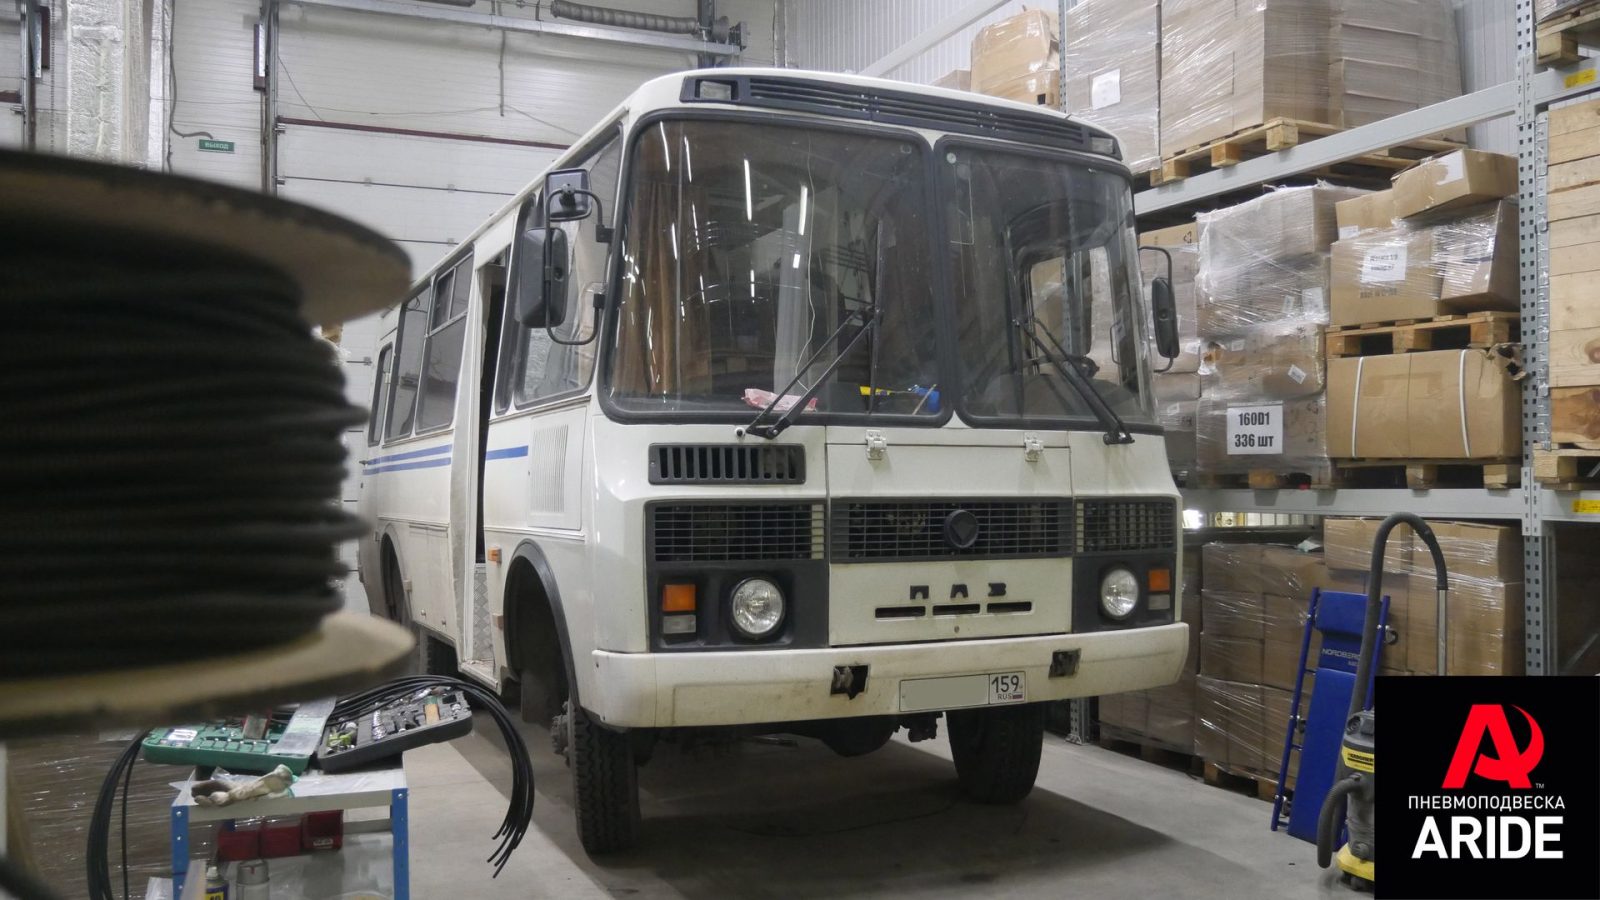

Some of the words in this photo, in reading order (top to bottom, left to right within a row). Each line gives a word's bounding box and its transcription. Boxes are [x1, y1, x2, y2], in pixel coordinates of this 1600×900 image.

[1238, 412, 1270, 426] 160D1
[1234, 433, 1255, 448] 336
[991, 674, 1020, 694] 159
[997, 692, 1013, 701] RUS
